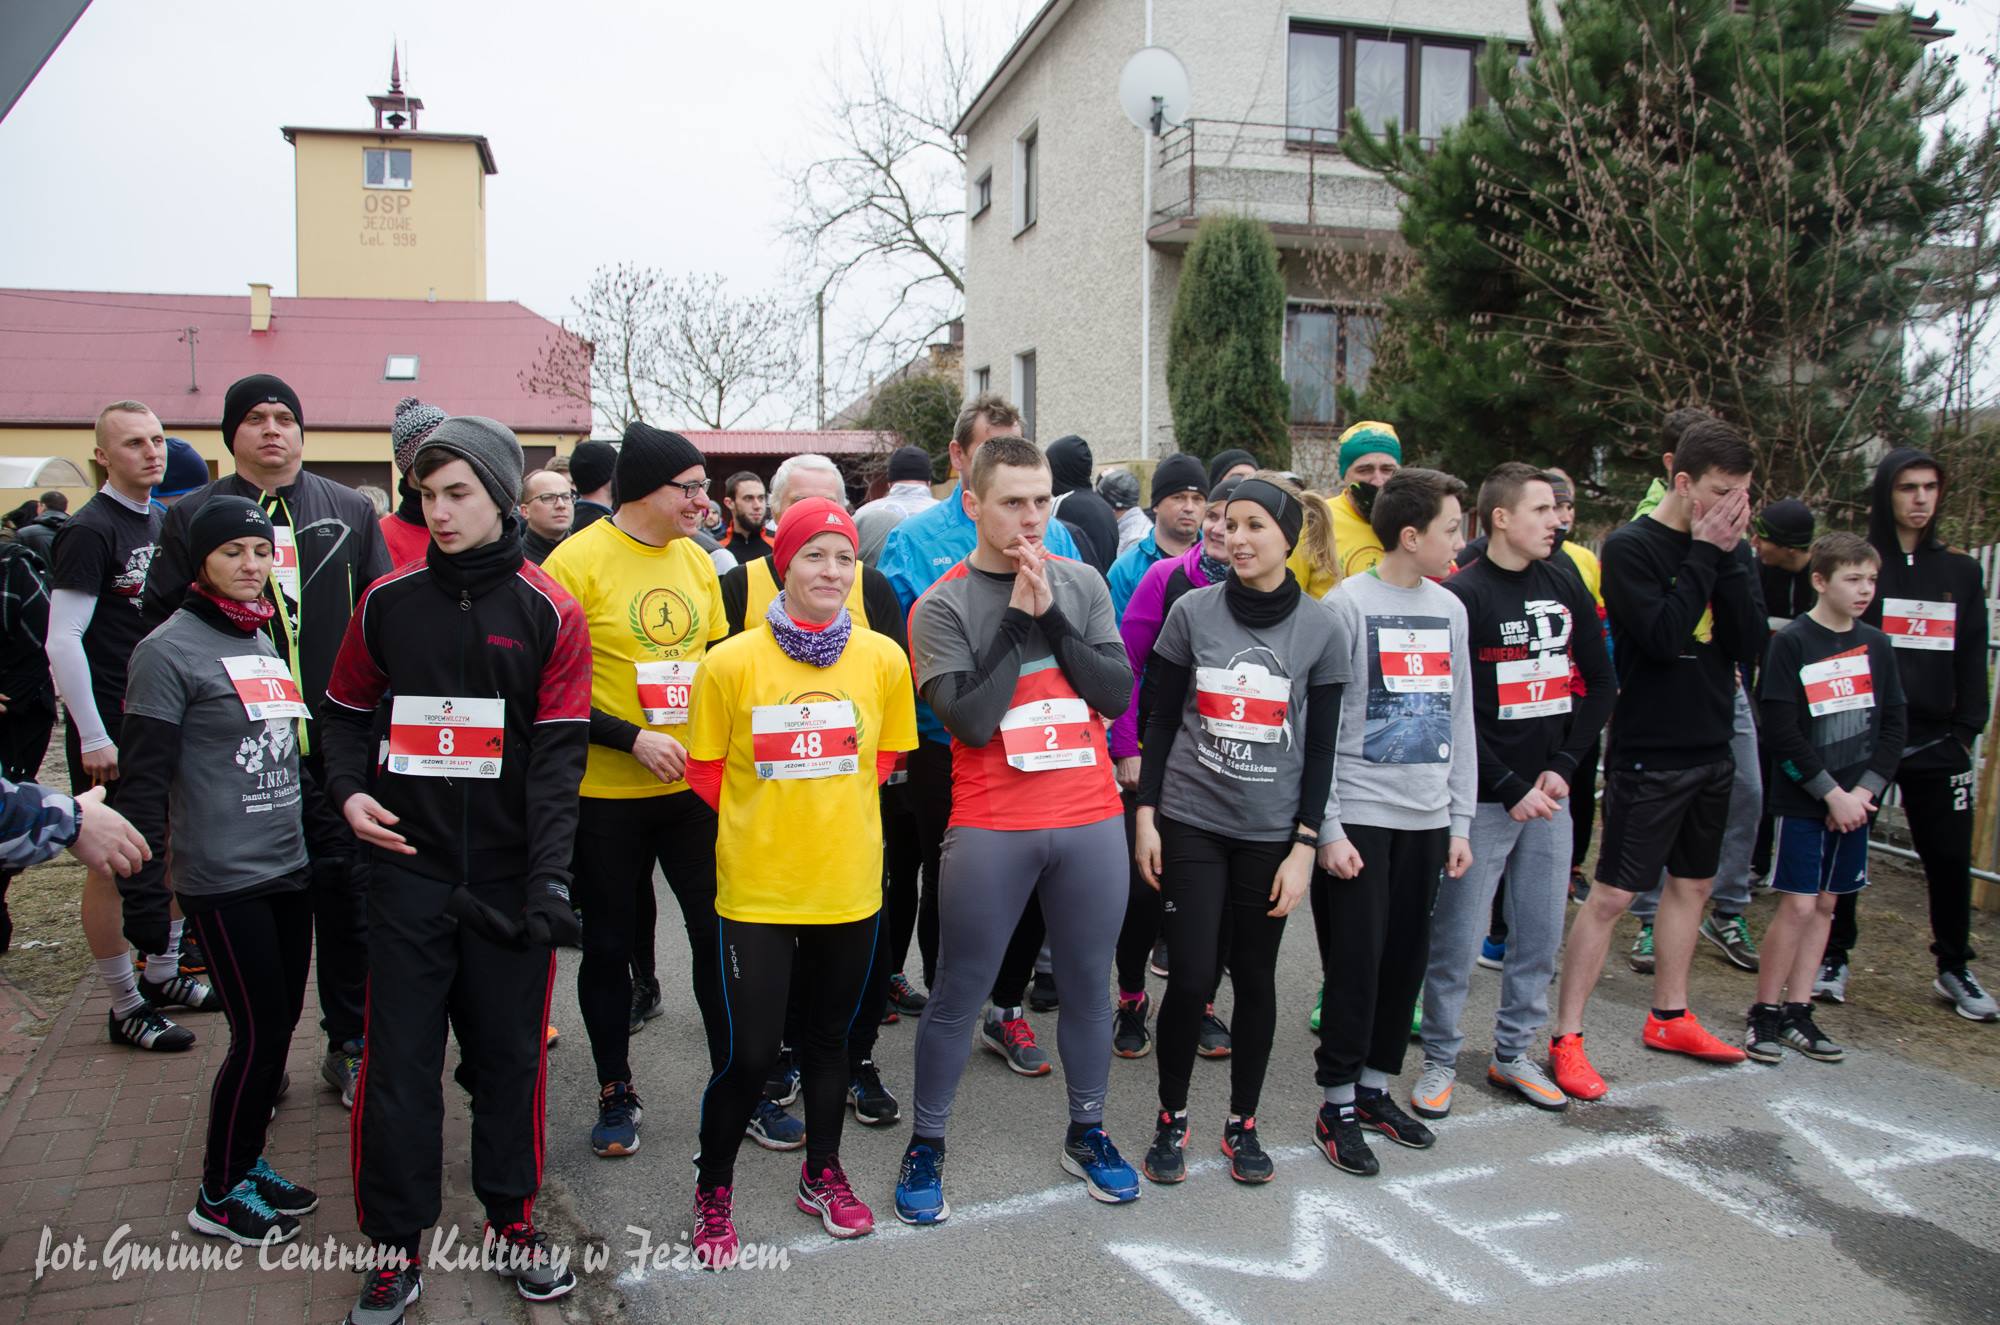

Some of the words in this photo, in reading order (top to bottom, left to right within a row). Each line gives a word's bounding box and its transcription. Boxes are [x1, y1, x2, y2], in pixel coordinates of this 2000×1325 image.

[364, 194, 411, 213] OSP
[392, 232, 417, 247] 998
[933, 556, 952, 566] SKB
[1500, 620, 1529, 635] LEPIEJ
[1906, 619, 1927, 636] 74
[1404, 653, 1424, 675] 18
[261, 678, 287, 700] 70
[666, 685, 689, 708] 60
[1526, 681, 1547, 702] 17
[1828, 677, 1855, 697] 118
[1230, 697, 1246, 721] 3
[438, 727, 454, 755] 8
[790, 731, 823, 759] 48
[1044, 725, 1059, 750] 2
[1197, 743, 1224, 763] Danuta
[1213, 737, 1253, 761] INKA
[256, 767, 291, 790] INKA
[241, 792, 271, 802] Danuta
[1106, 1094, 2000, 1325] META
